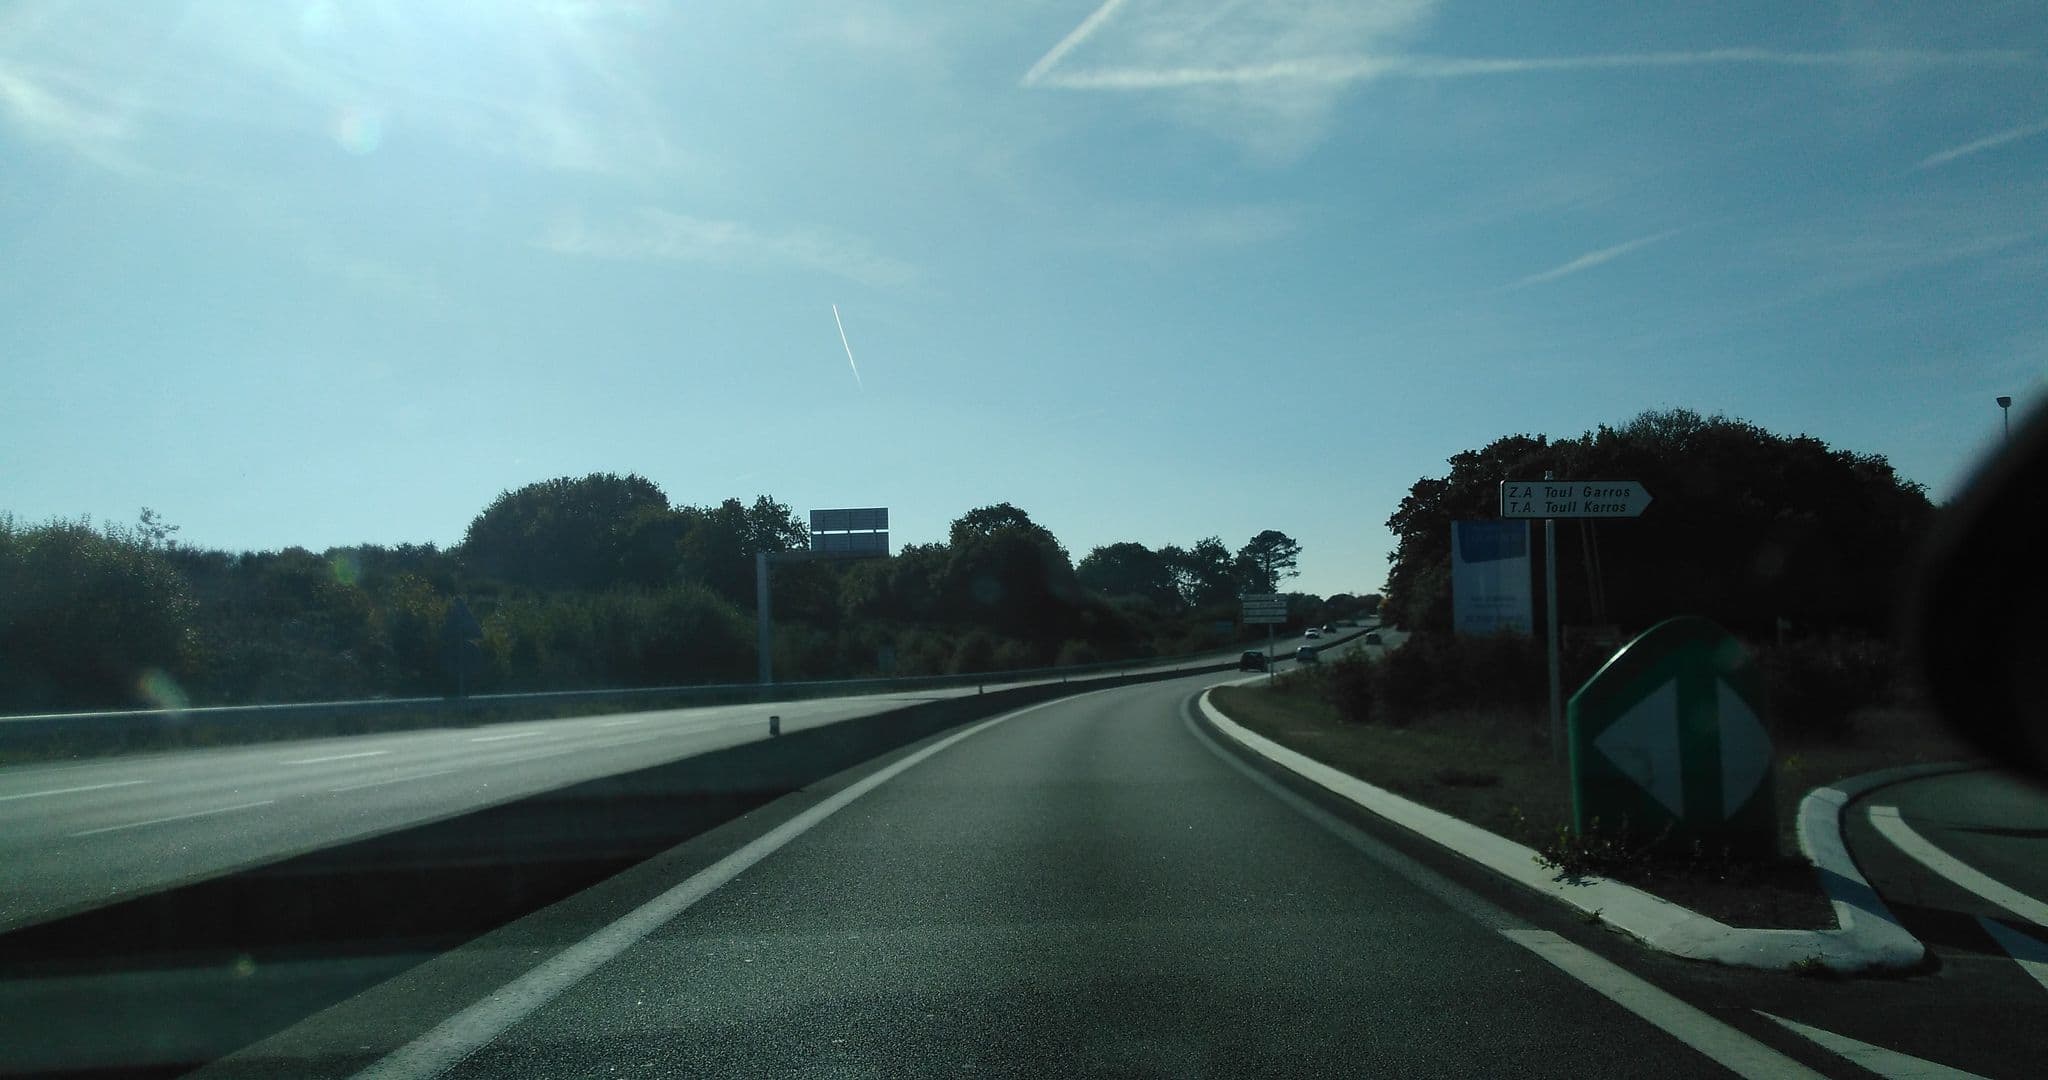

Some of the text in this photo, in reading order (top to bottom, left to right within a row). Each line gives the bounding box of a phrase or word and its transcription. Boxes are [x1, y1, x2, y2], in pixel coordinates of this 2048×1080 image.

[1544, 486, 1573, 498] Toul
[1583, 486, 1631, 498] Garros
[1510, 501, 1626, 513] T.A. Toull Karros
